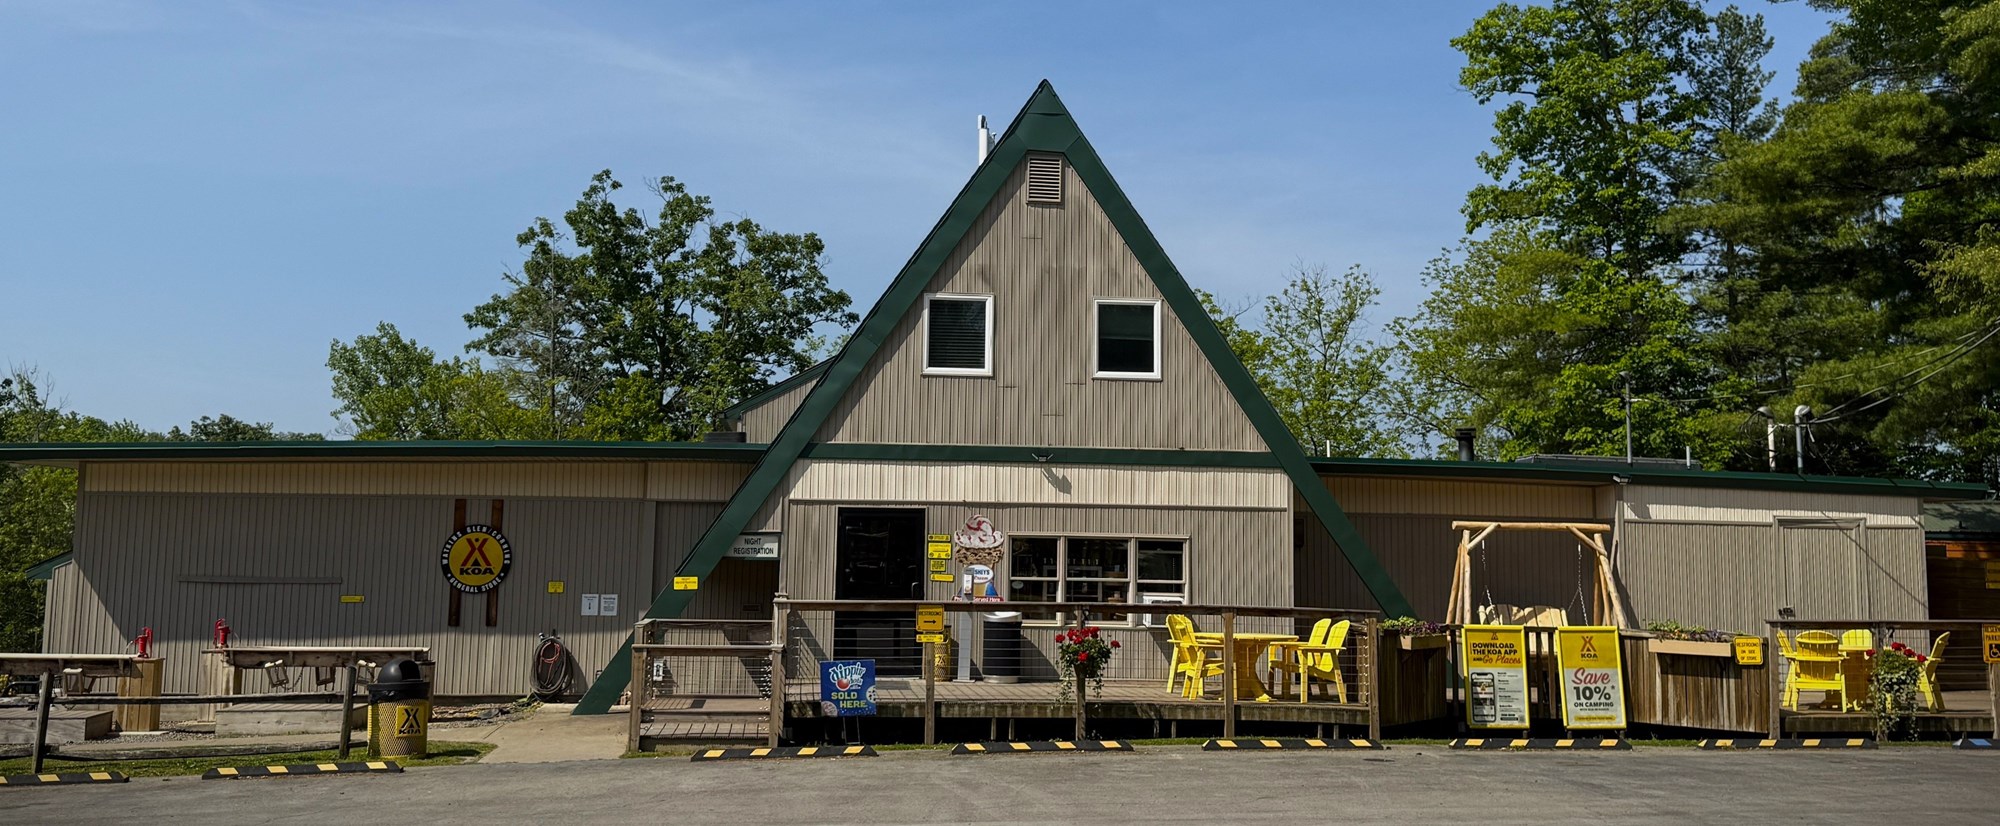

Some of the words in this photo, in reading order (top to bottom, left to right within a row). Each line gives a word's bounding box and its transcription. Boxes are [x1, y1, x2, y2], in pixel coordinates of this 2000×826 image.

[744, 537, 762, 546] NIGHT
[441, 531, 463, 565] WATKINS
[733, 547, 775, 555] REGISTRATION
[459, 567, 495, 576] KOA
[449, 577, 479, 593] GENERAL
[481, 576, 502, 592] STORE
[1483, 655, 1493, 664] Go
[1495, 655, 1522, 664] Places
[1571, 667, 1611, 685] Save
[831, 691, 858, 700] SOLD
[839, 700, 868, 709] HERE
